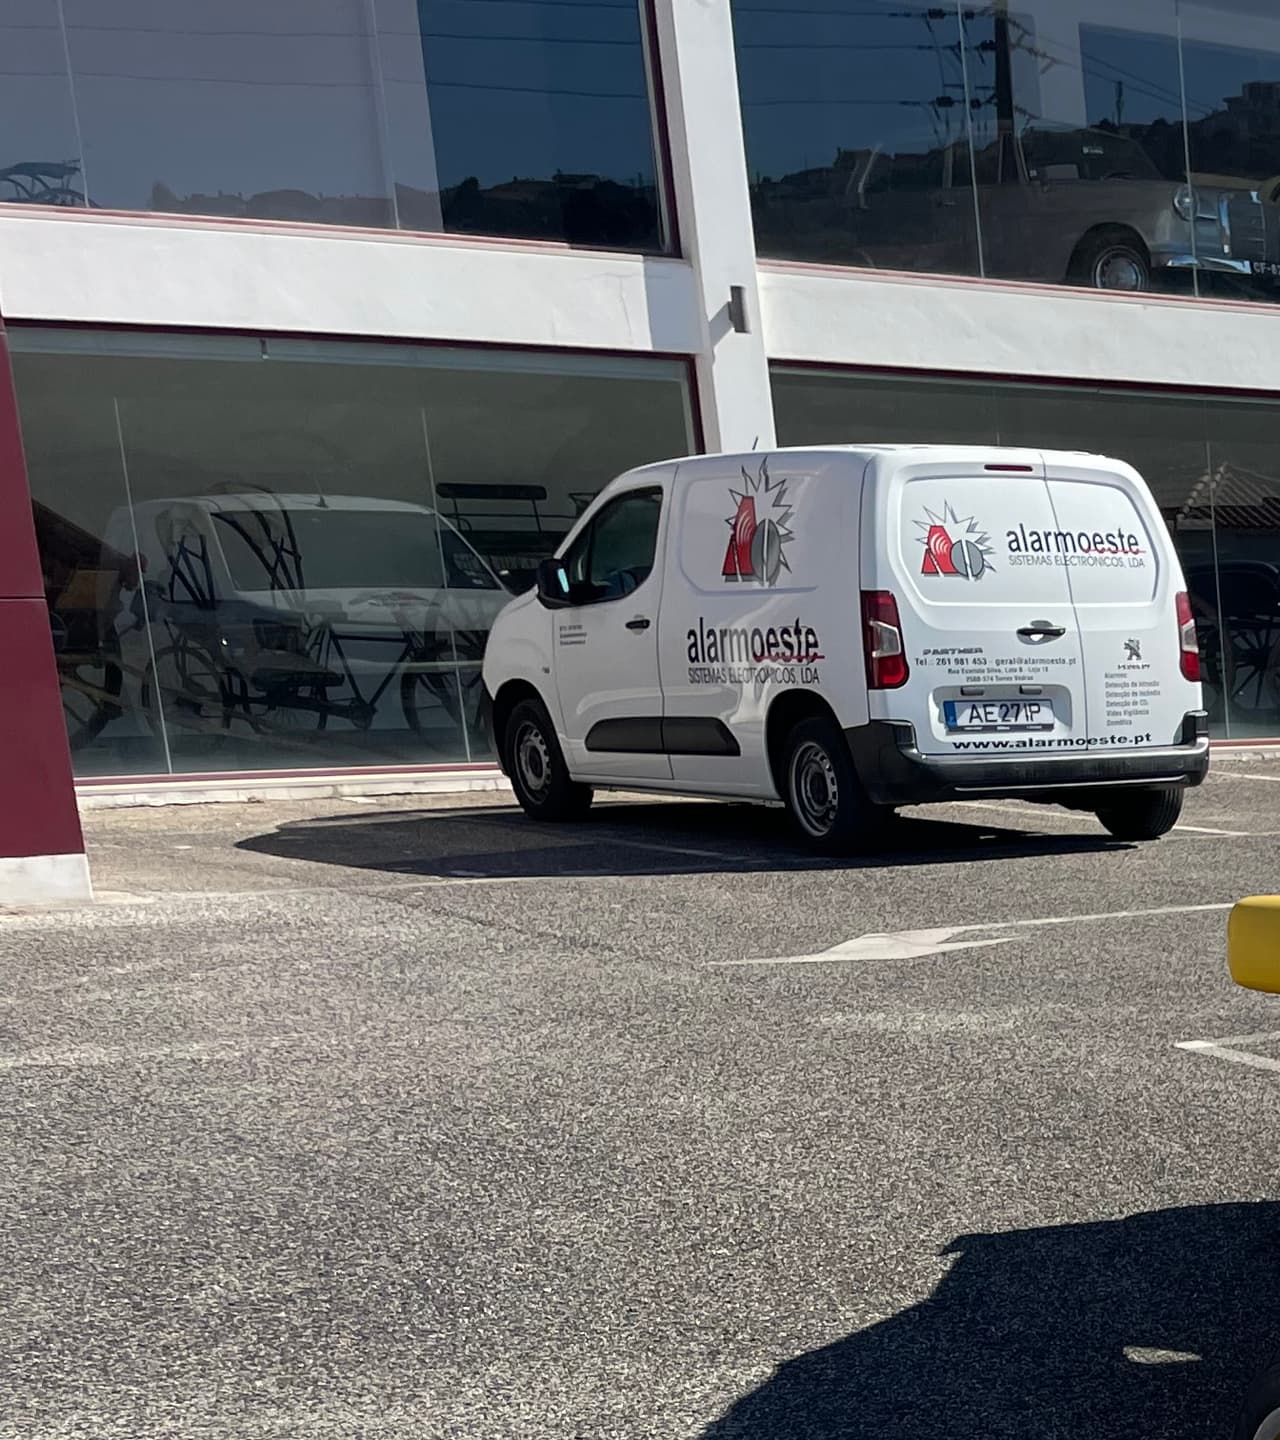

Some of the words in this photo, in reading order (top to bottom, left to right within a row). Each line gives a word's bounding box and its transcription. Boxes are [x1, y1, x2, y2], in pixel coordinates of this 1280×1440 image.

[1006, 523, 1139, 555] alarmoeste
[1008, 555, 1053, 566] SISTEMAS
[1128, 557, 1145, 568] LDA
[687, 616, 819, 664] alarmoeste
[688, 667, 727, 685] SISTEMAS
[801, 667, 821, 685] LDA
[953, 733, 1152, 749] www.alarmoeste.pt
